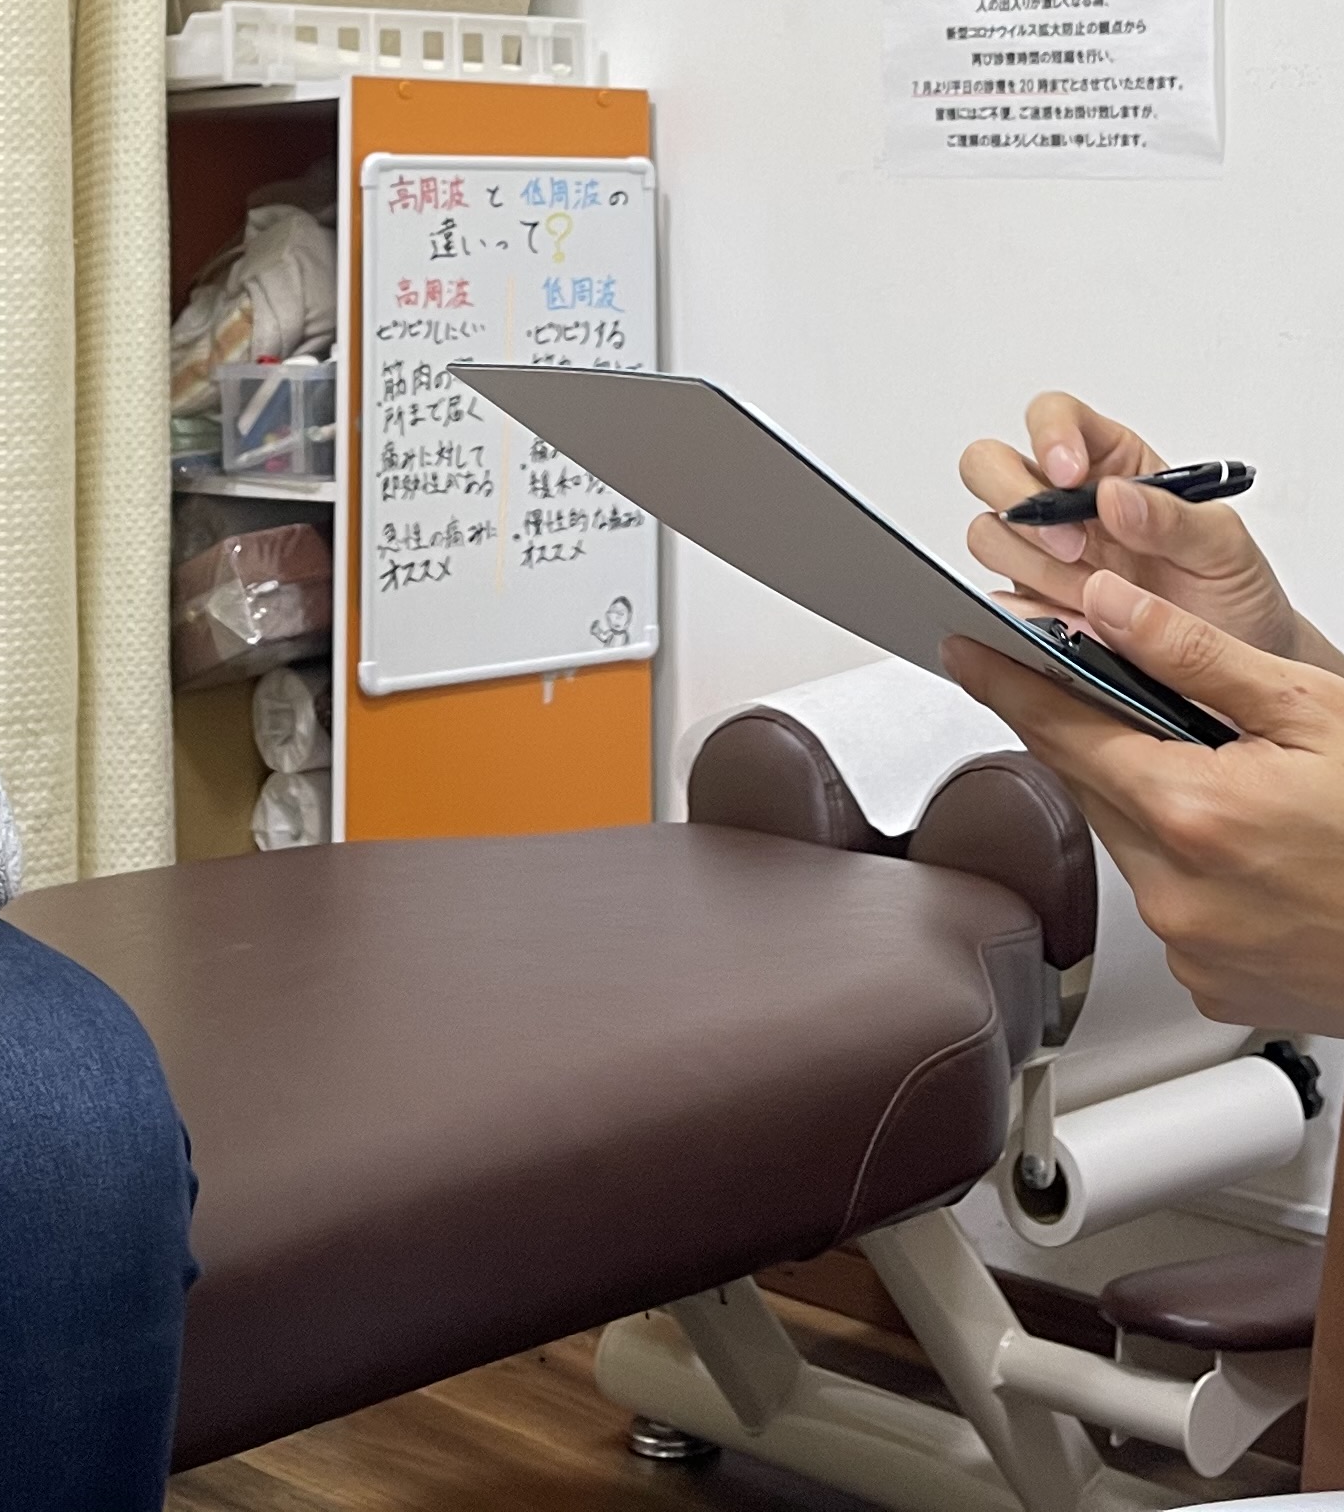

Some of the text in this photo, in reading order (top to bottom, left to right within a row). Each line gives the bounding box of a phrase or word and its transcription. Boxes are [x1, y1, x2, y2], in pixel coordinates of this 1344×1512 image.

[395, 276, 474, 309] 高周波
[542, 275, 625, 312] 低周波
[381, 356, 473, 402] 筋肉の
[520, 540, 586, 569] オススメ
[380, 556, 452, 592] オススメ
